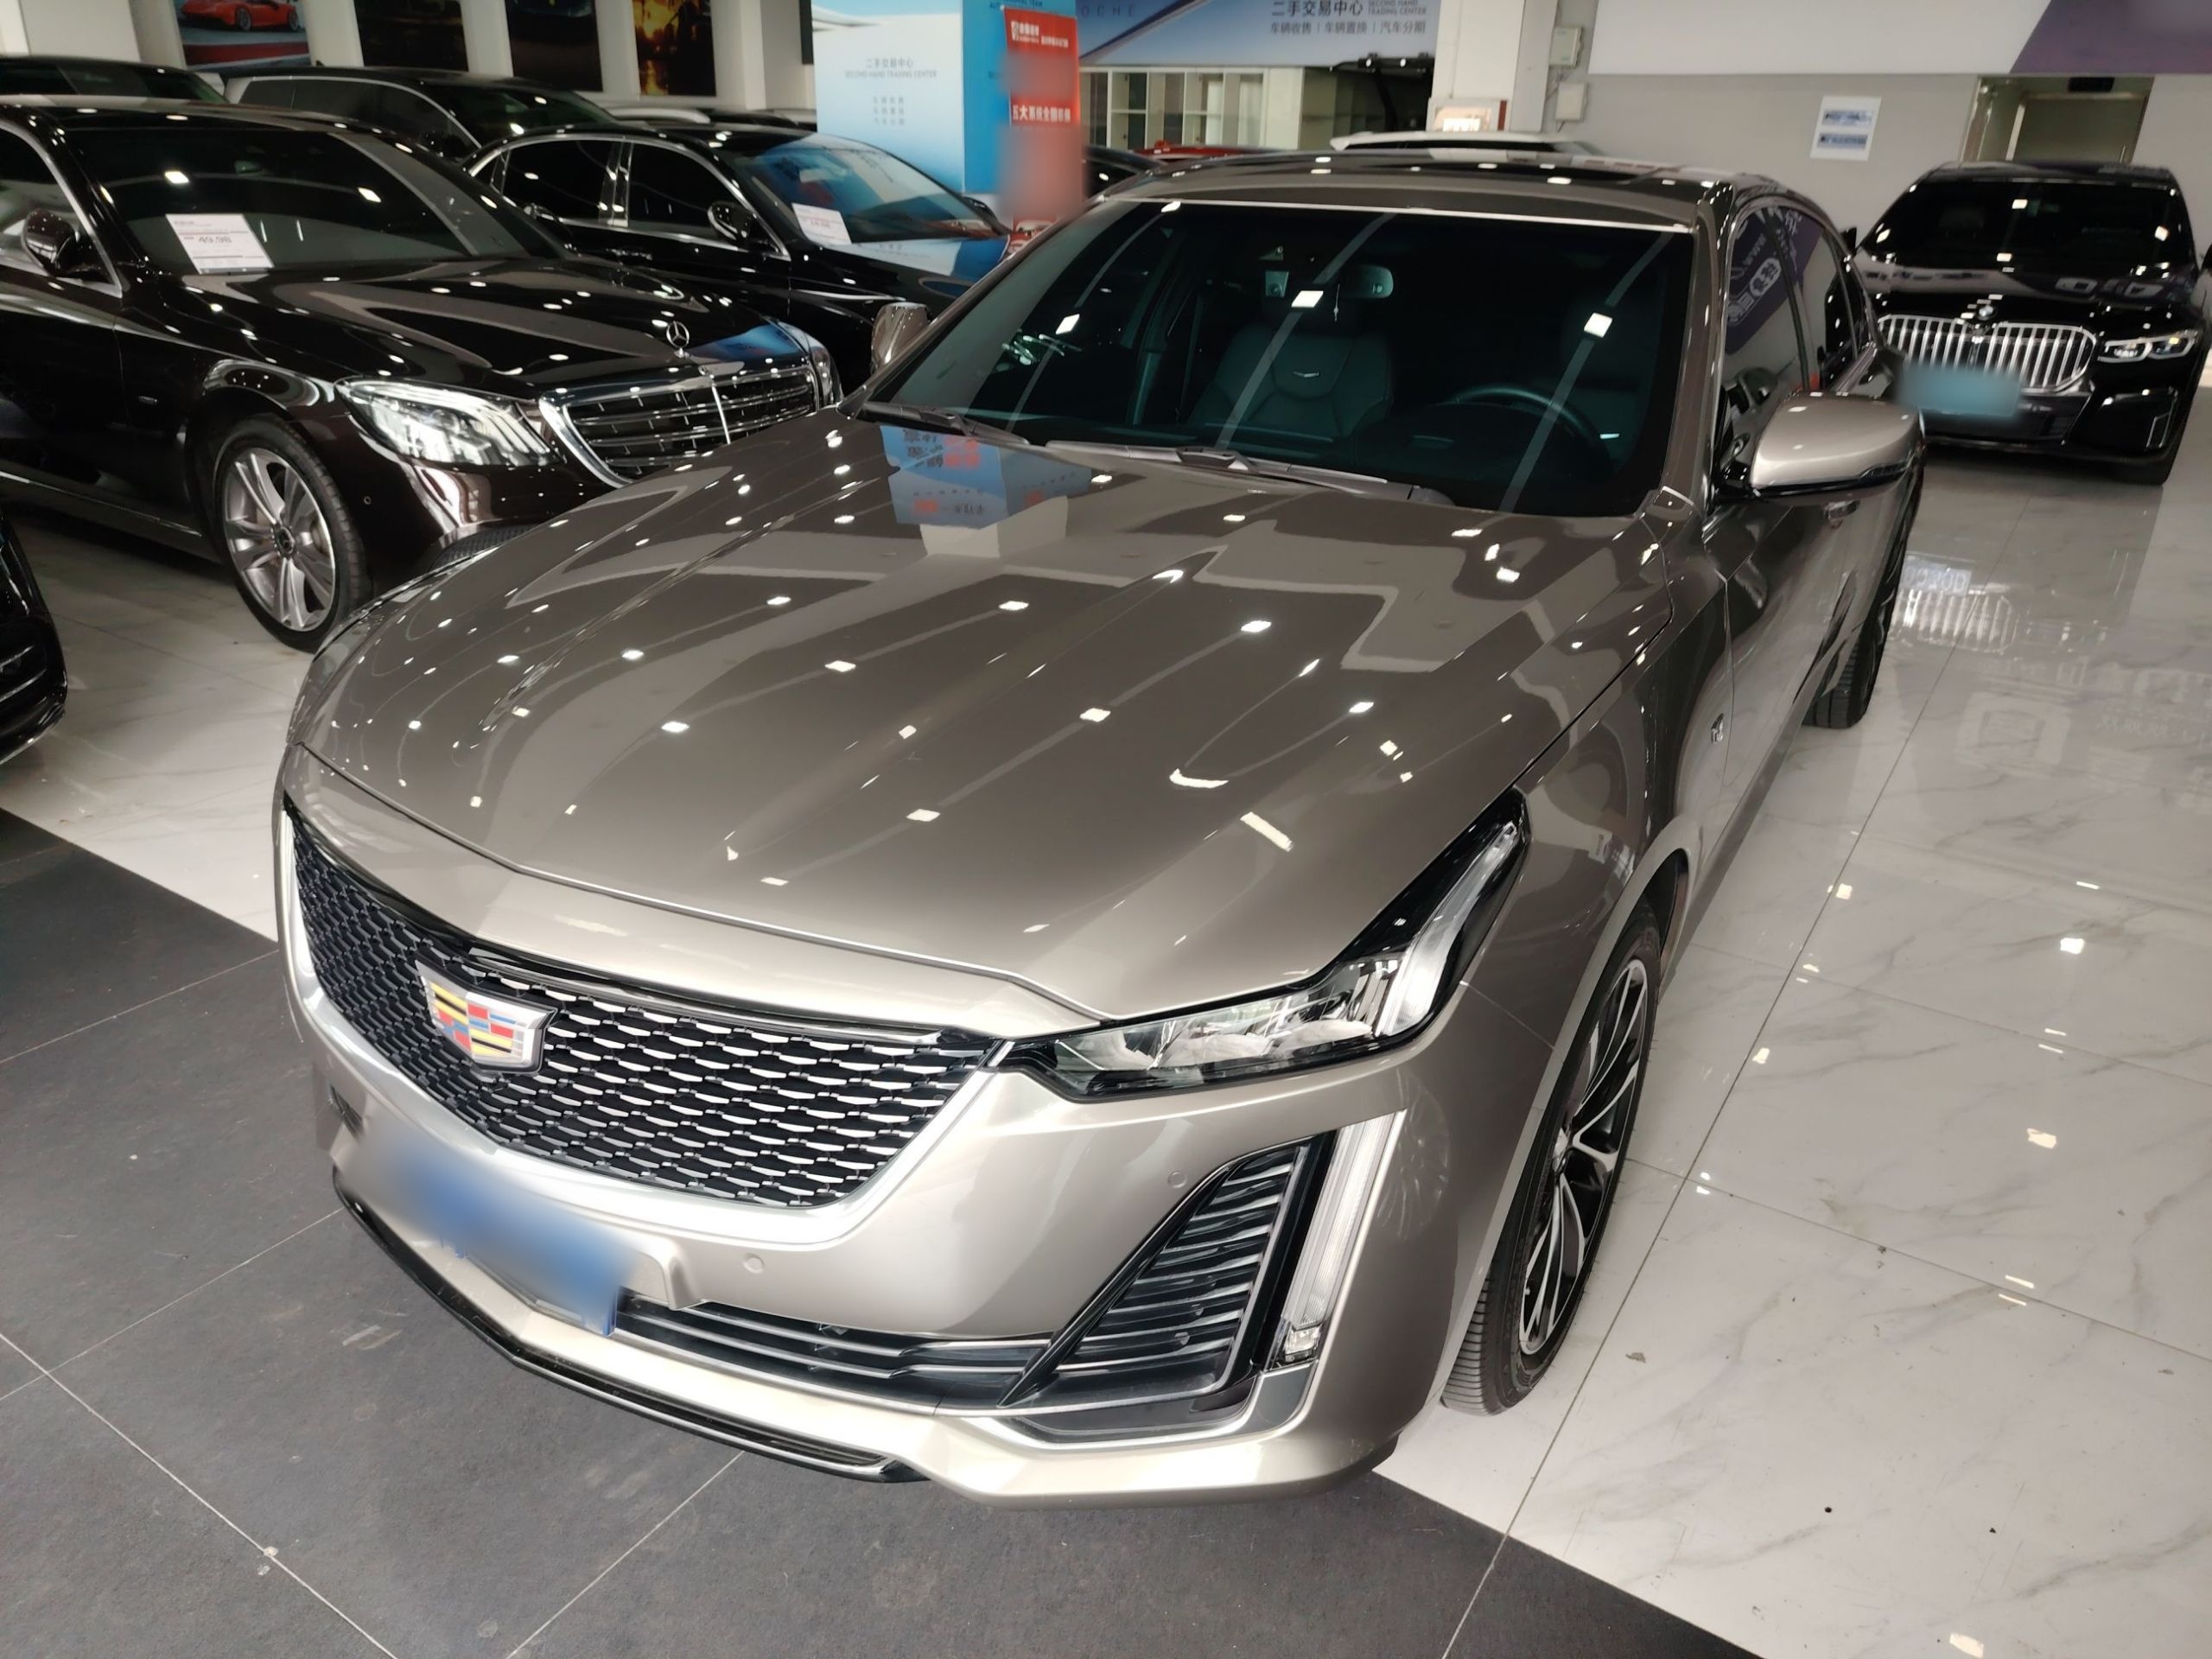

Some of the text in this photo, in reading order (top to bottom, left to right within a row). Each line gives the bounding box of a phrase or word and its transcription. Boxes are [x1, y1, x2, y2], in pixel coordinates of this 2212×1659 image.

[1272, 0, 1363, 16] 二手交易中心
